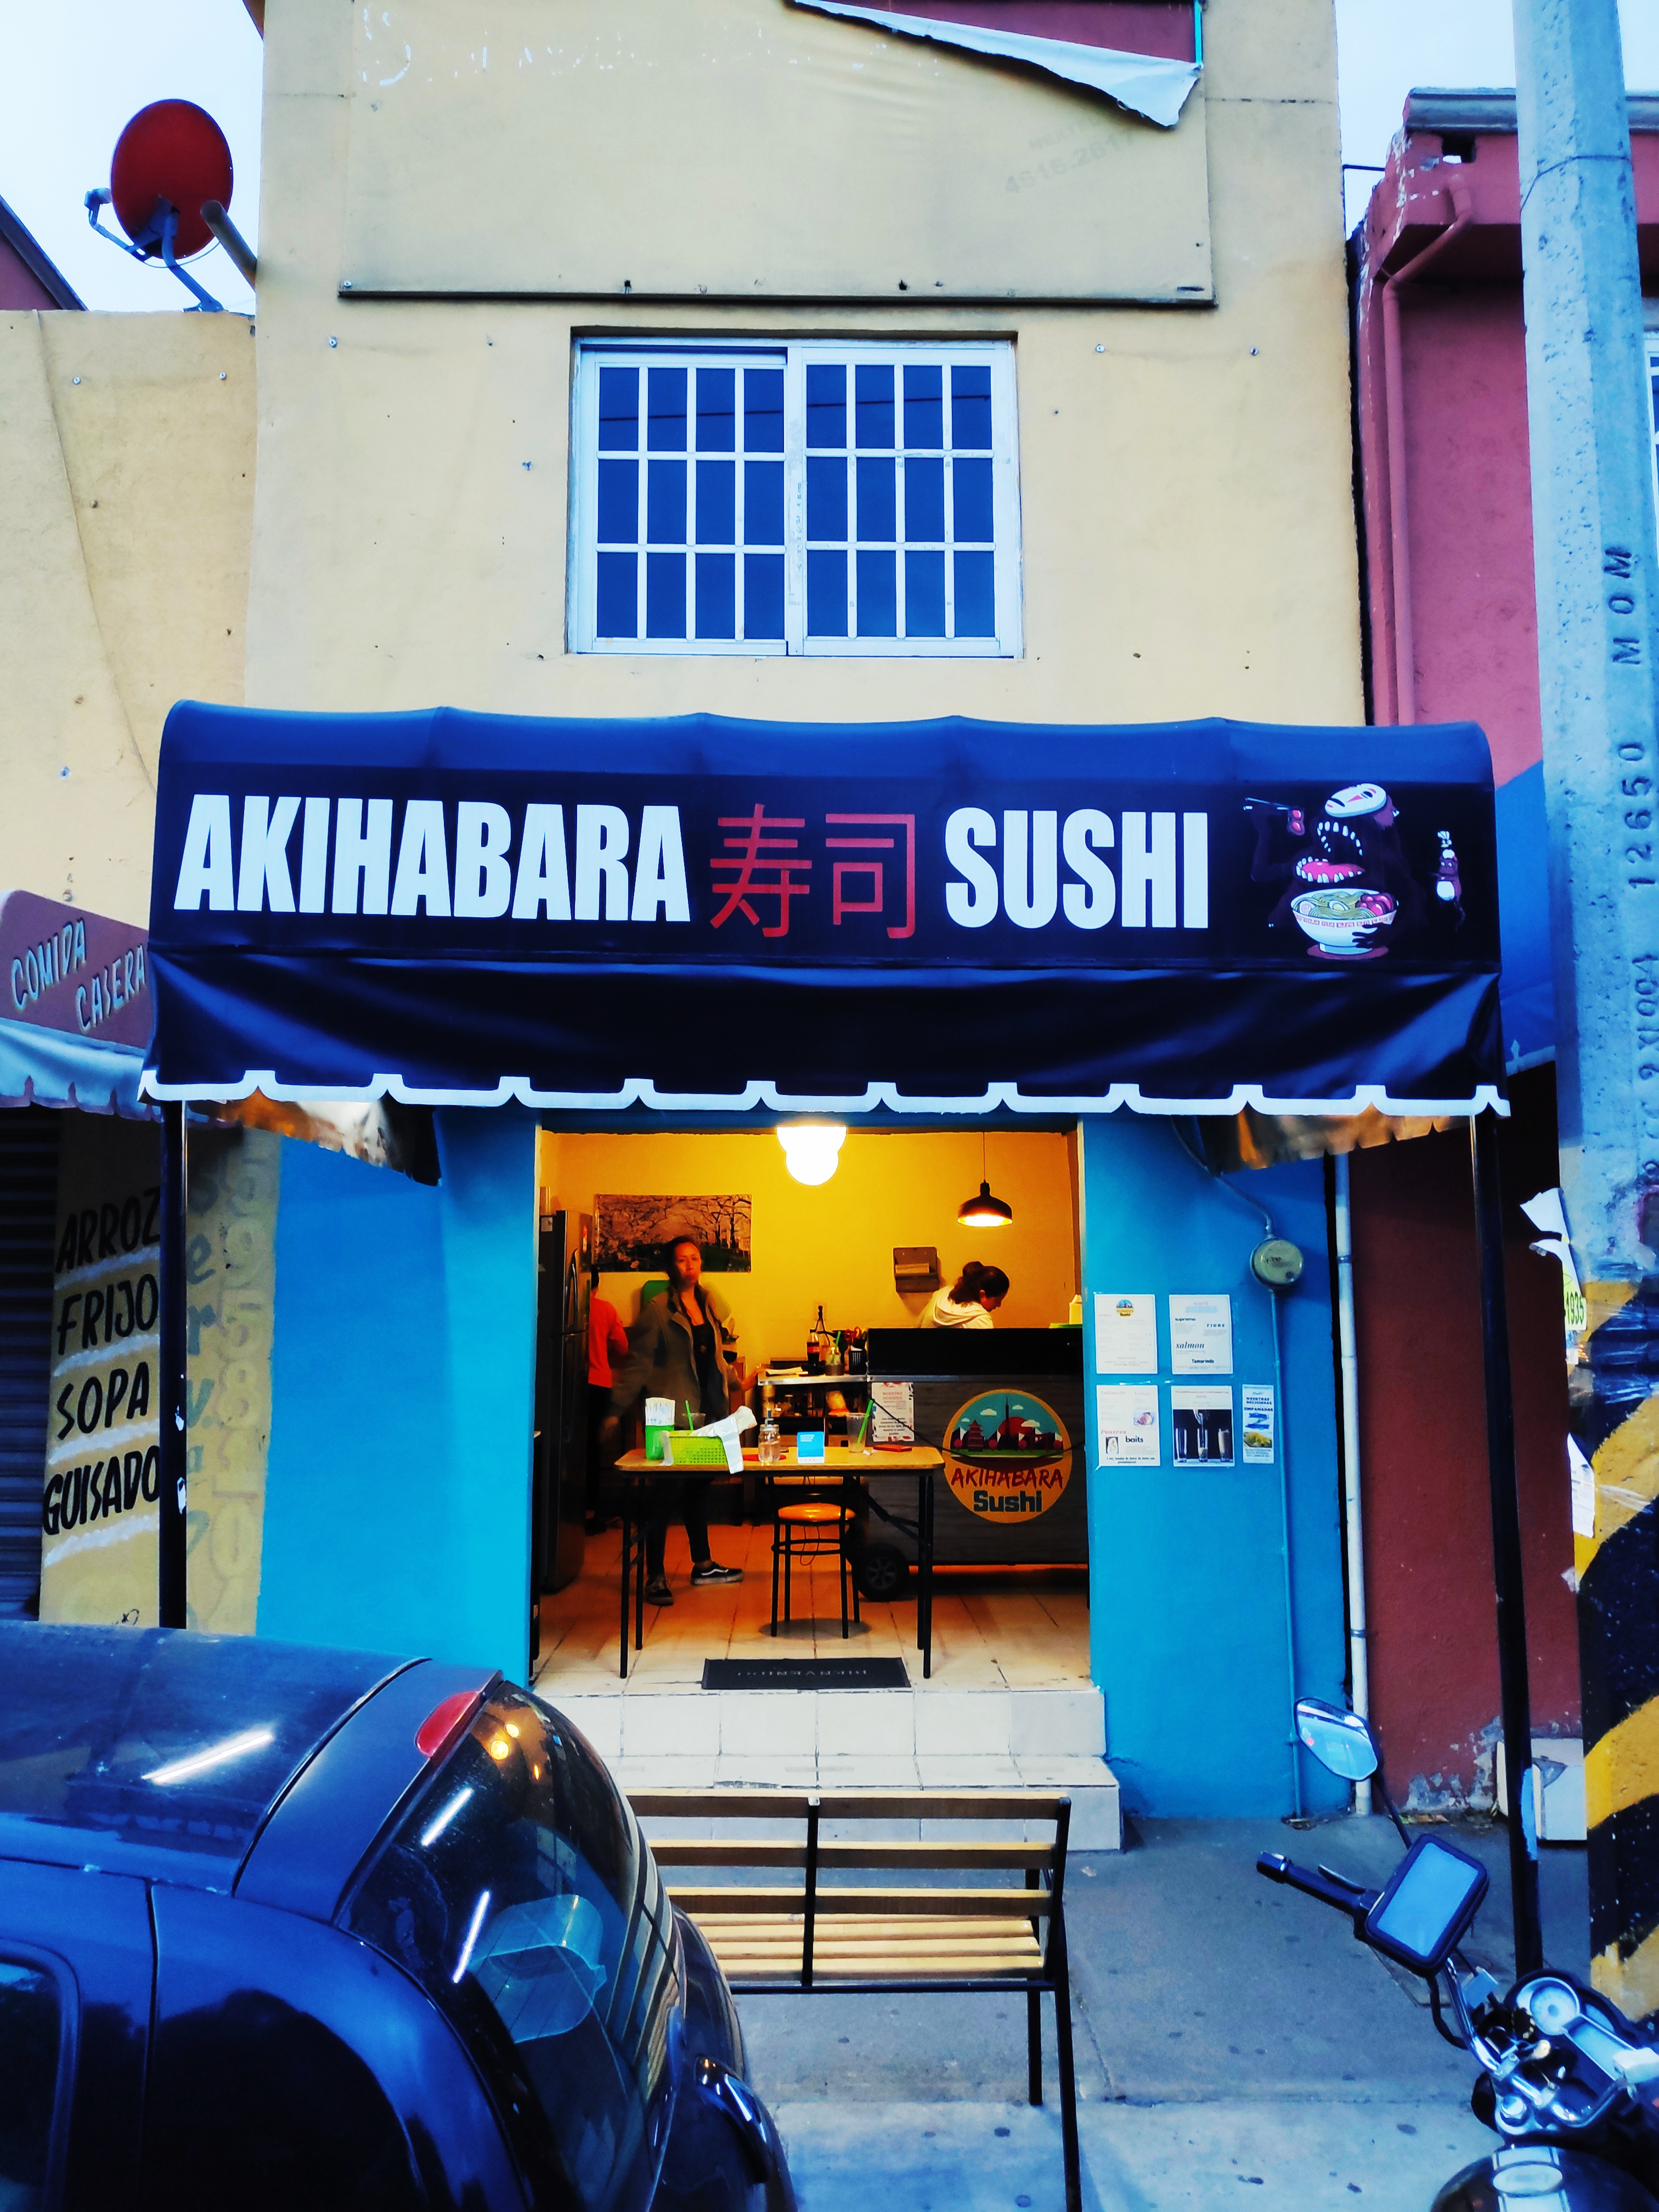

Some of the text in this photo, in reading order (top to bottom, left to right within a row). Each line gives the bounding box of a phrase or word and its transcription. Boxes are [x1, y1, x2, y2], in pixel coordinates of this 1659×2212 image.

[1604, 550, 1641, 664] MOM
[173, 793, 1209, 939] AKIHABARA 寿司 SUSHI
[11, 918, 87, 1011] COMIDA
[76, 944, 148, 1034] CASERA
[55, 1186, 160, 1273] ARROZ
[57, 1361, 150, 1441] SOPA
[951, 1468, 1064, 1489] AKIHABARA
[973, 1490, 1042, 1513] Sushi
